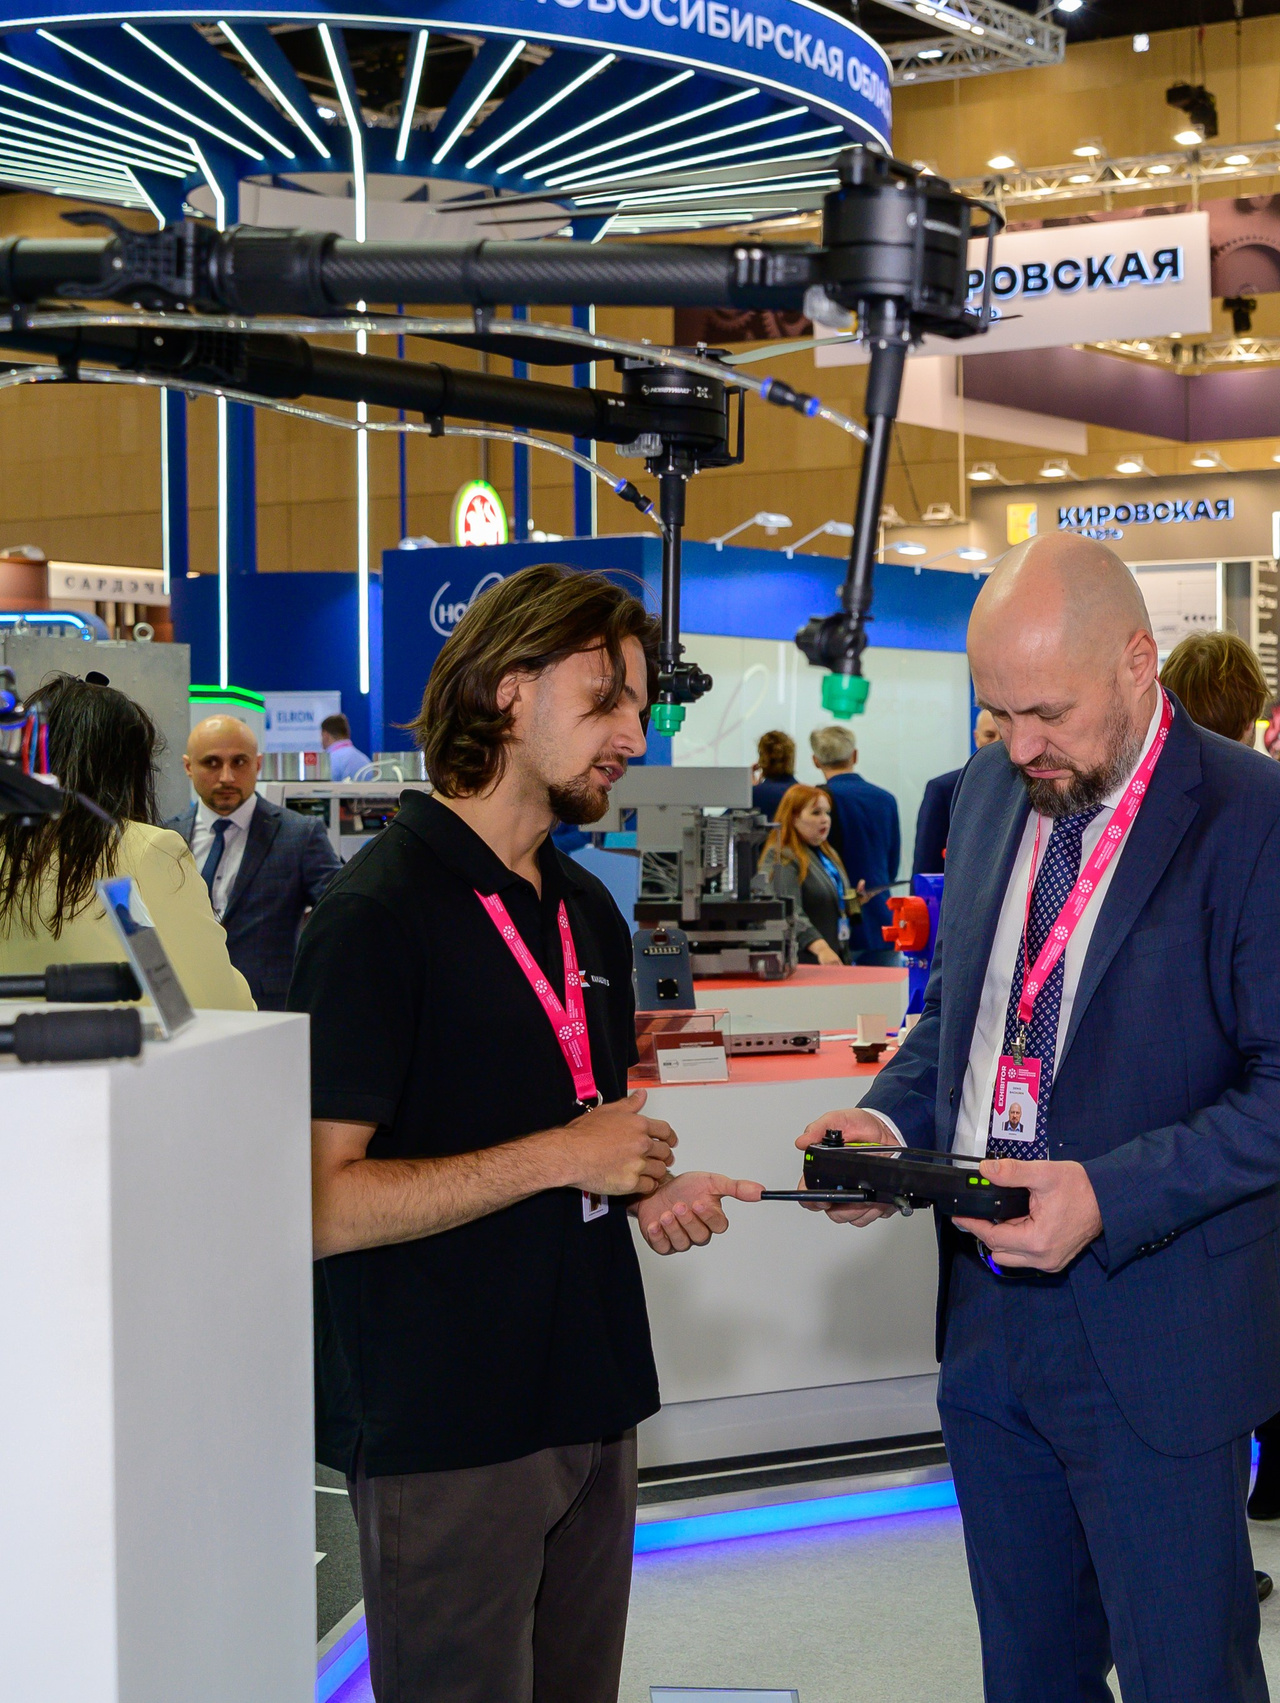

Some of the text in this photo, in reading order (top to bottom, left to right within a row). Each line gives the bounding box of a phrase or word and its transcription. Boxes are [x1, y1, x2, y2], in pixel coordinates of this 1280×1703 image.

[536, 0, 845, 83] ОСИБИРСКАЯ
[966, 246, 1184, 301] РОВСКАЯ
[1058, 498, 1235, 529] КИРОВСКАЯ
[64, 576, 165, 595] САРДЭЧ
[998, 1065, 1007, 1107] EXHIBITOR
